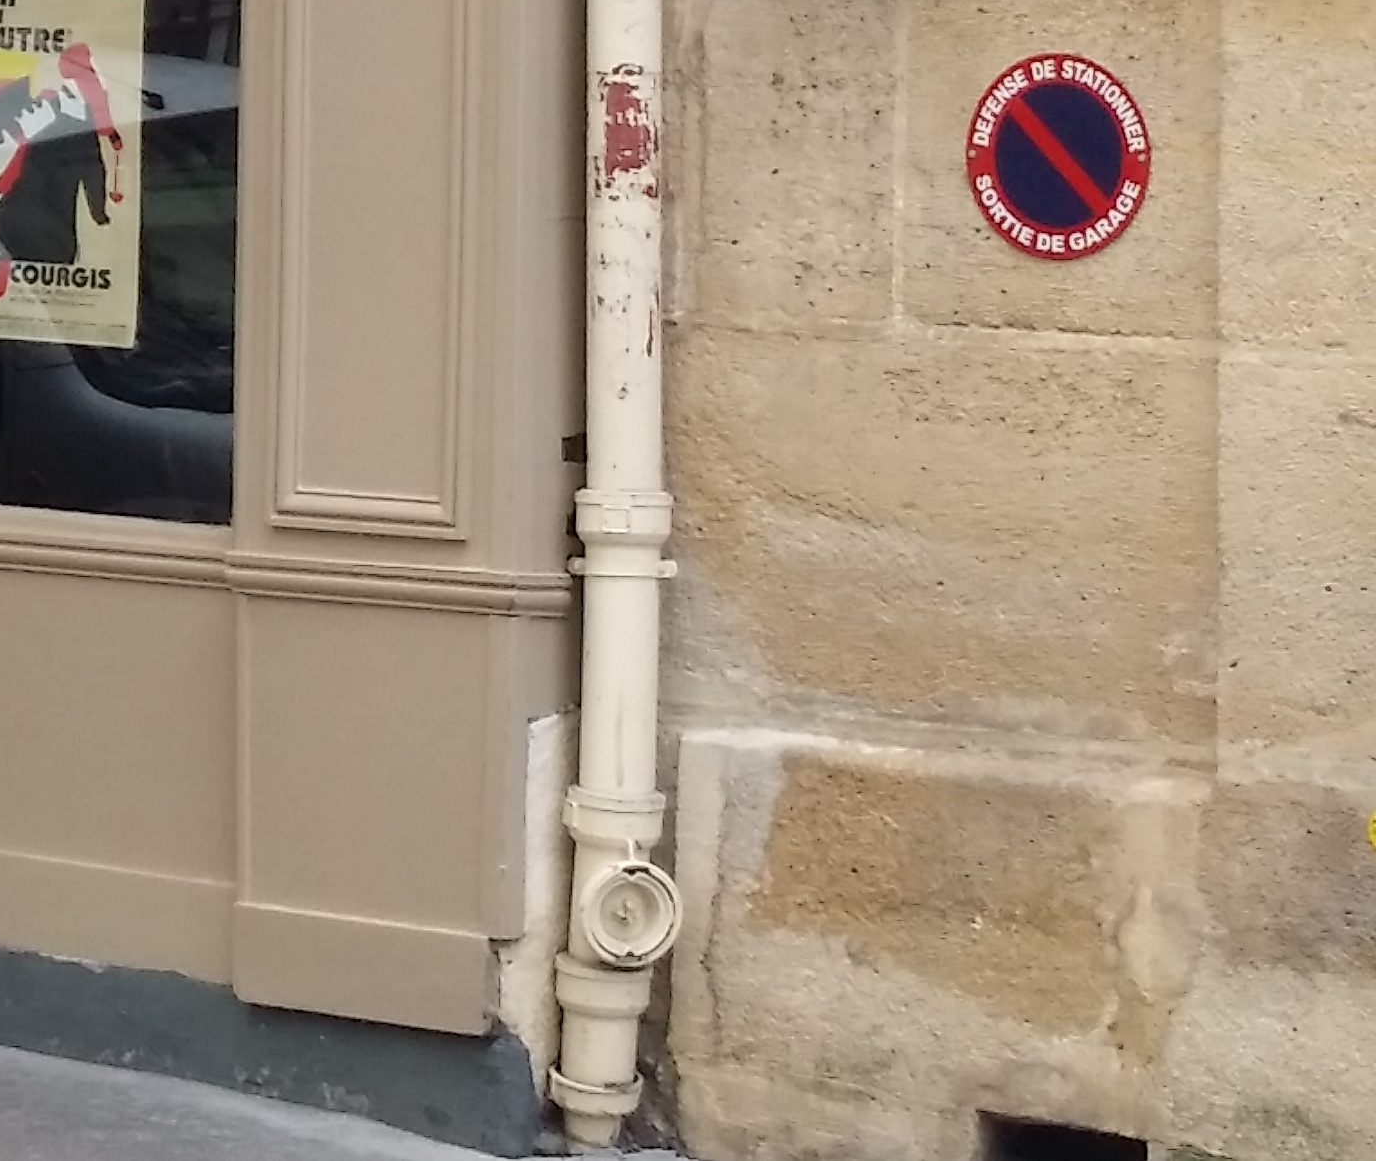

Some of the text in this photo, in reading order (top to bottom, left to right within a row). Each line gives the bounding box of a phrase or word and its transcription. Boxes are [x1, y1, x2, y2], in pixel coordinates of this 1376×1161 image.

[972, 59, 1146, 153] DEFENSE DE STATIONNER
[976, 174, 1141, 253] SORTIE DE GARAGE
[11, 263, 111, 289] COURGIS
